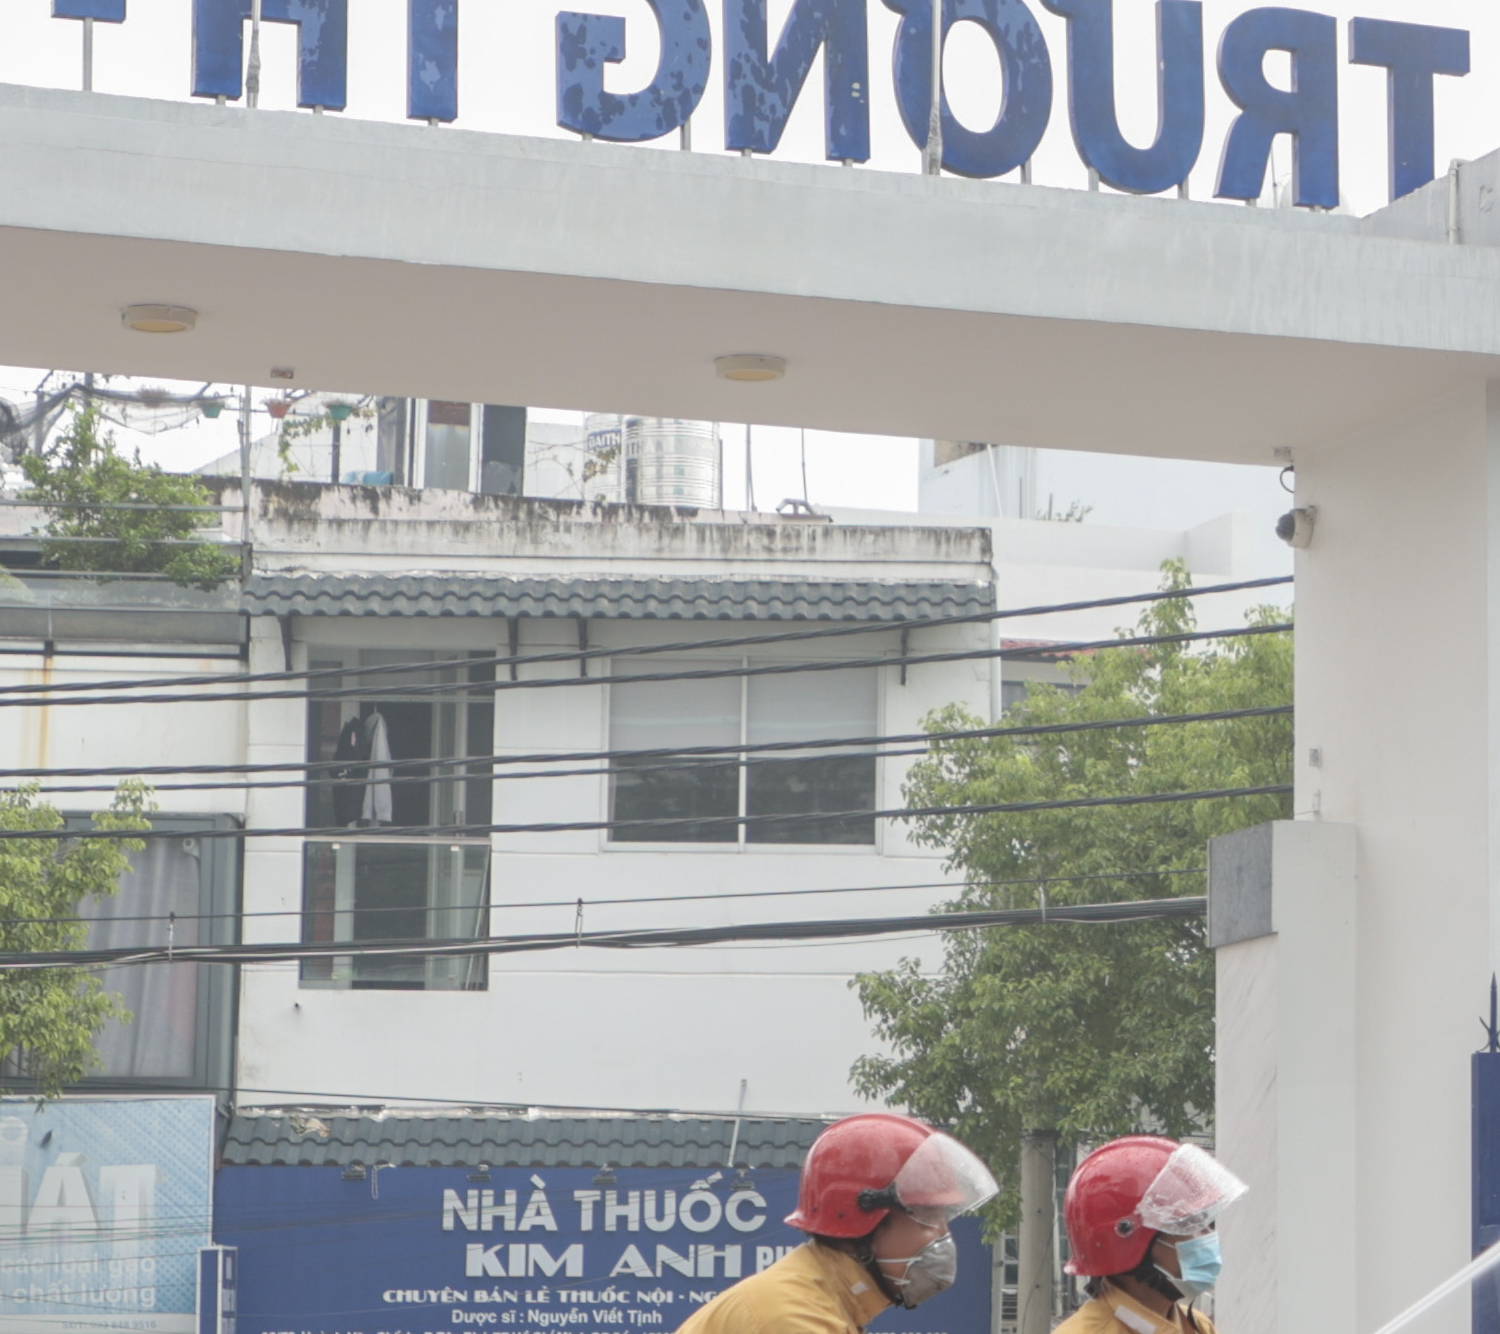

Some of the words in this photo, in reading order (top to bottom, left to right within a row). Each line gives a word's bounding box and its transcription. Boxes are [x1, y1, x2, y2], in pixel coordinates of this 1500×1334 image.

[442, 1173, 558, 1232] NHÀ
[573, 1171, 768, 1233] THUỐC
[465, 1243, 584, 1278] KIM
[609, 1244, 743, 1278] ANH
[11, 1279, 73, 1304] chất
[80, 1280, 156, 1308] lượng
[382, 1286, 468, 1304] CHUYÊN
[474, 1285, 518, 1304] BÁN
[525, 1285, 550, 1304] LẺ
[556, 1285, 630, 1304] THUỐC
[637, 1287, 674, 1306] NỘI
[452, 1309, 497, 1327] Dược
[528, 1307, 588, 1327] Nguyễn
[627, 1309, 663, 1327] Tịnh
